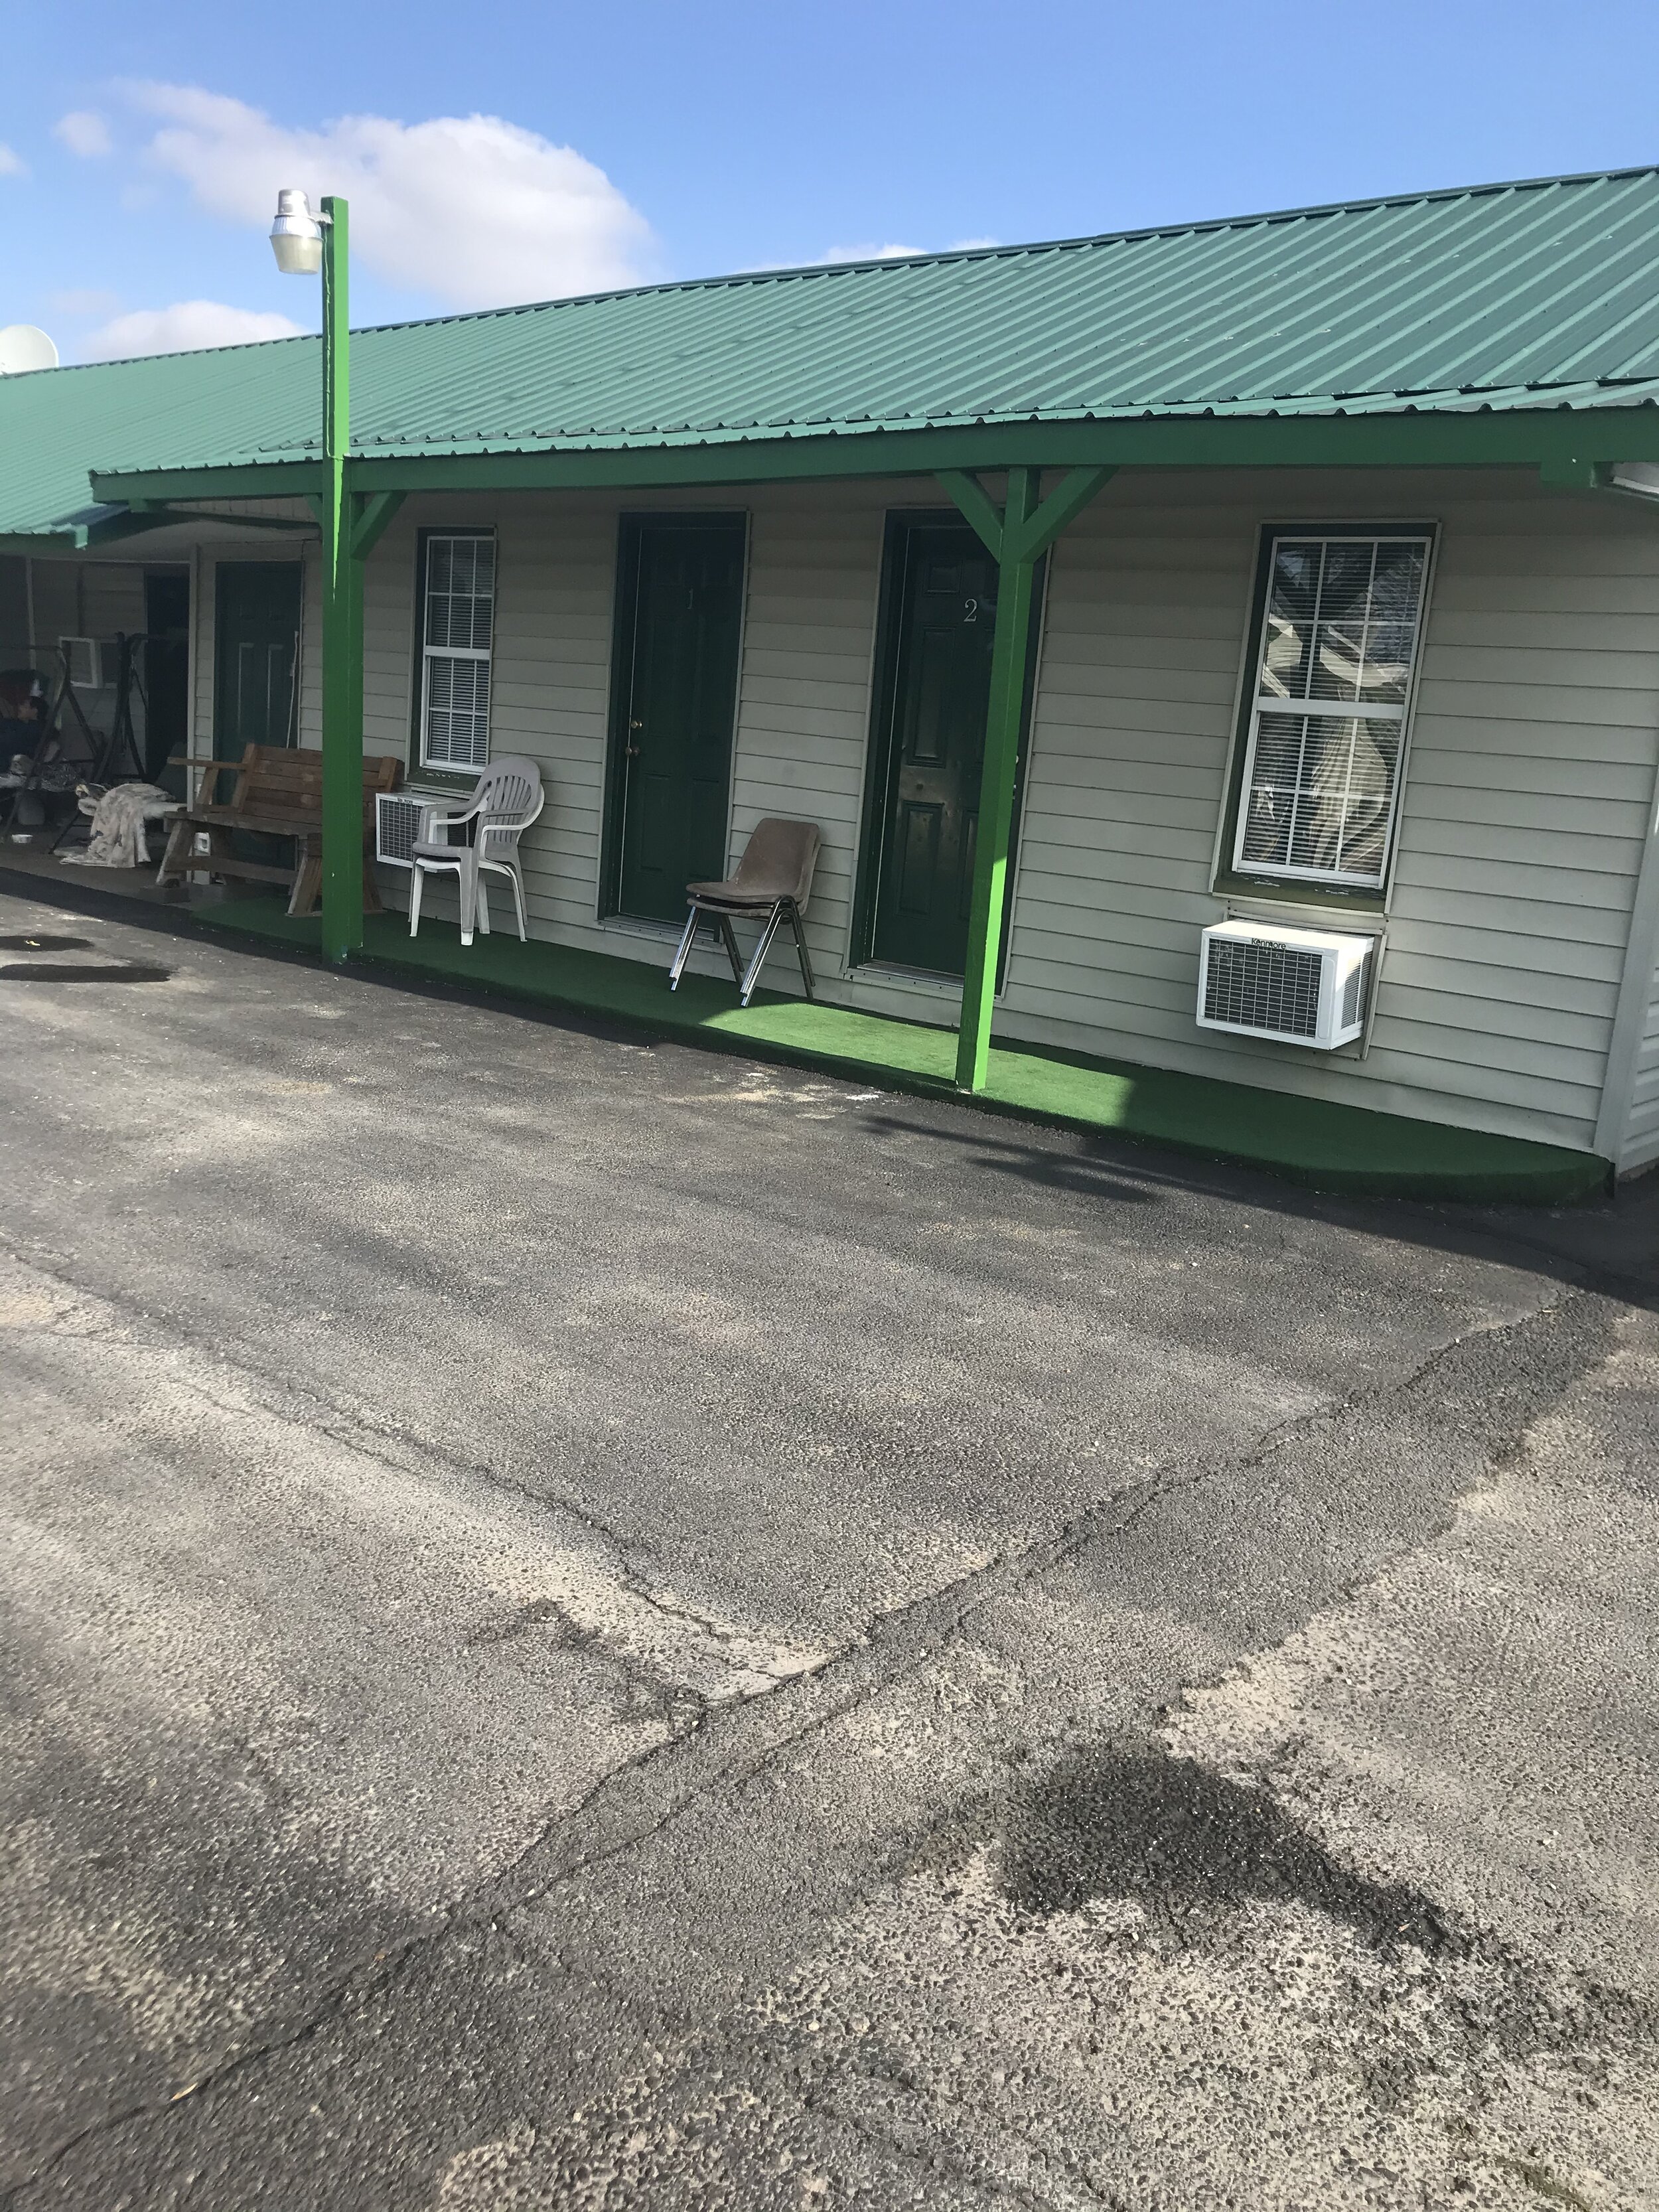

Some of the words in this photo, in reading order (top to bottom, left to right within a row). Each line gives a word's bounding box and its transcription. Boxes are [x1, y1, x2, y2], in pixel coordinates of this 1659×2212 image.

[687, 588, 693, 609] 1
[964, 599, 977, 622] 2
[1252, 937, 1286, 950] Kenmore
